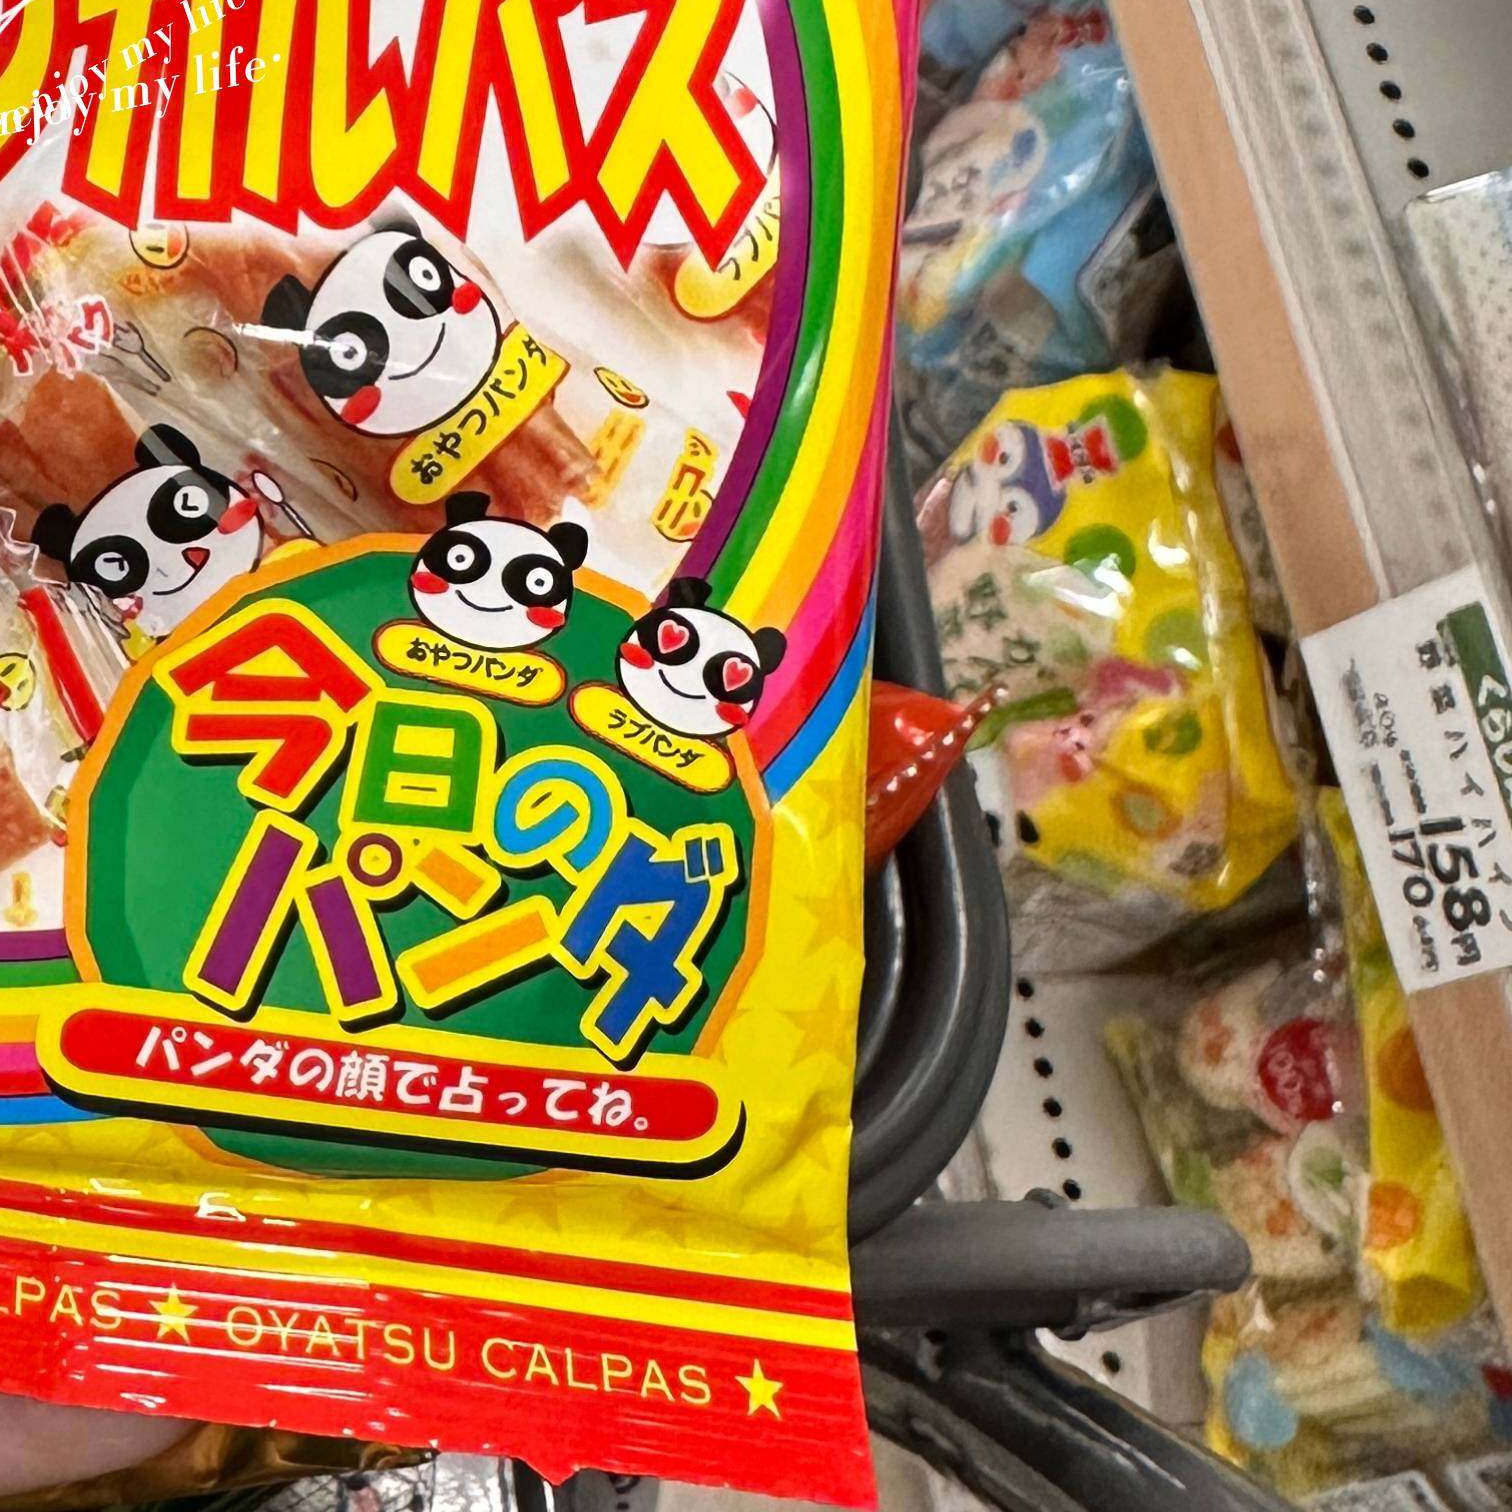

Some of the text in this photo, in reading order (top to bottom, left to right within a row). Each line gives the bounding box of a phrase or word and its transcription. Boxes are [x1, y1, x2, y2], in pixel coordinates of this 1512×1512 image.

[409, 332, 549, 487] おやつパンダ
[404, 635, 547, 689] おやつパンダ
[166, 609, 614, 874] 今日の
[605, 704, 706, 772] ラブパンダ
[1388, 829, 1435, 909] 170
[1419, 816, 1492, 967] 158円
[197, 822, 726, 1049] パンダ
[135, 1024, 653, 1135] パンダの顔で占ってね。
[226, 1306, 458, 1373] OYATSU
[480, 1338, 714, 1408] CALPAS
